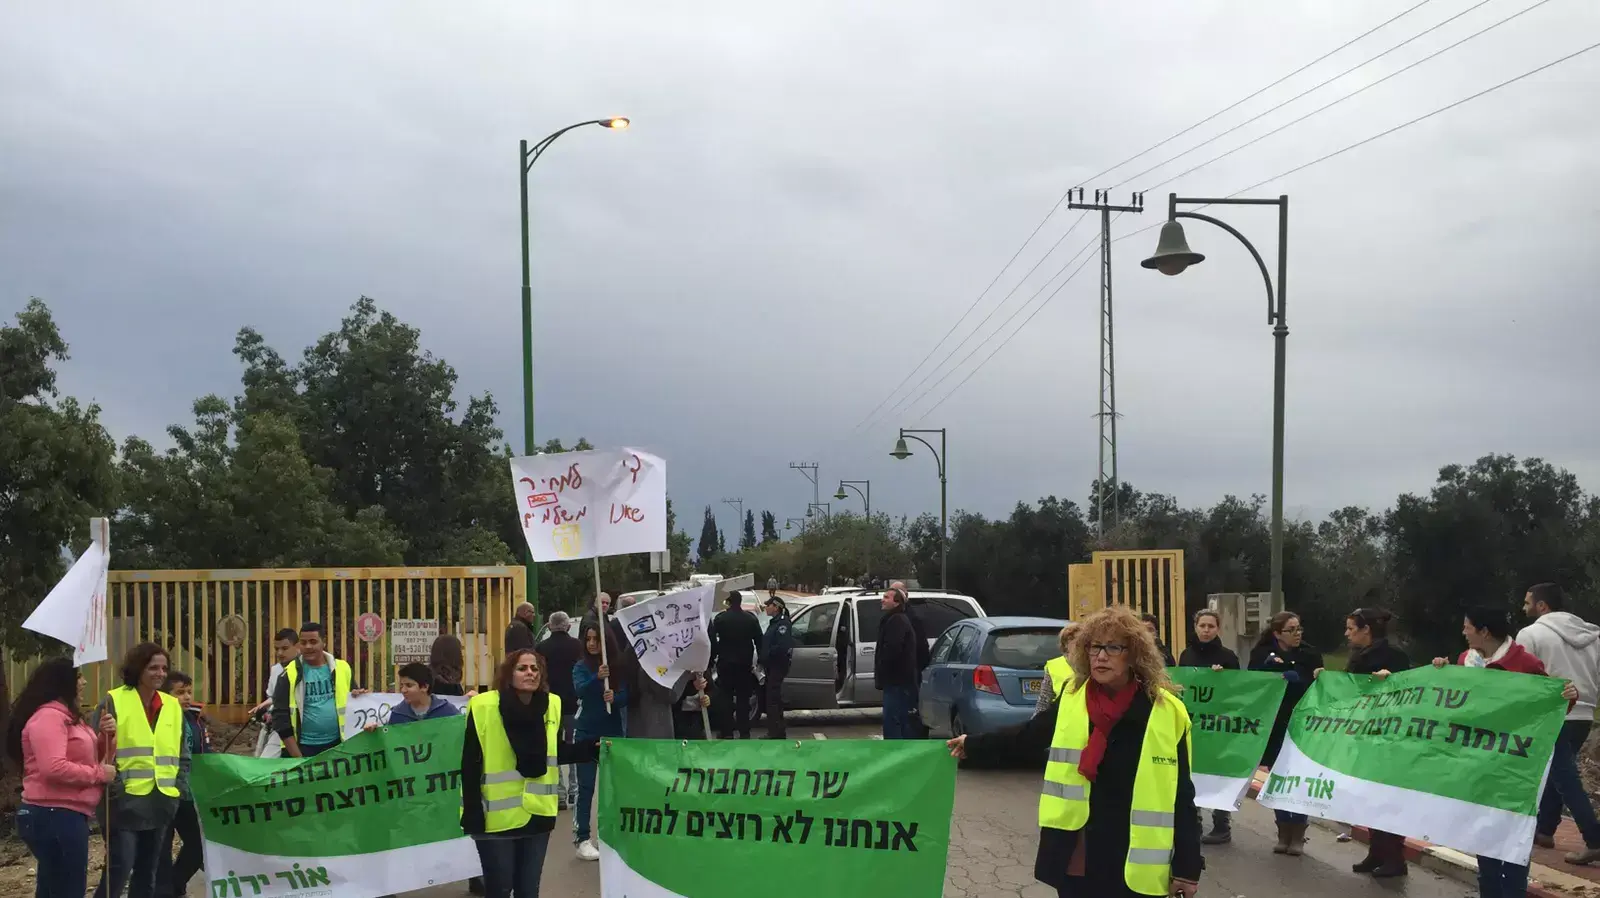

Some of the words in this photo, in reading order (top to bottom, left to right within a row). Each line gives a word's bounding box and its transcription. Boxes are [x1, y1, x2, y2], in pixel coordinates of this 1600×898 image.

[519, 463, 582, 492] למחיר
[622, 454, 641, 483] די
[1190, 685, 1214, 703] שר
[1432, 687, 1471, 709] שר
[1200, 714, 1261, 735] אנחנו
[1305, 715, 1364, 735] סידרתי
[1362, 716, 1402, 735] רוצח
[1406, 717, 1439, 739] זה
[394, 742, 432, 765] שר
[1445, 722, 1533, 758] צומת
[387, 776, 415, 799] זה
[665, 767, 796, 797] התחבורה,
[806, 770, 849, 799] שר
[210, 797, 305, 826] סידרתי
[315, 784, 380, 813] רוצח
[619, 803, 680, 836] למות
[686, 810, 763, 842] רוצים
[772, 809, 814, 845] לא
[823, 817, 919, 852] אנחנו
